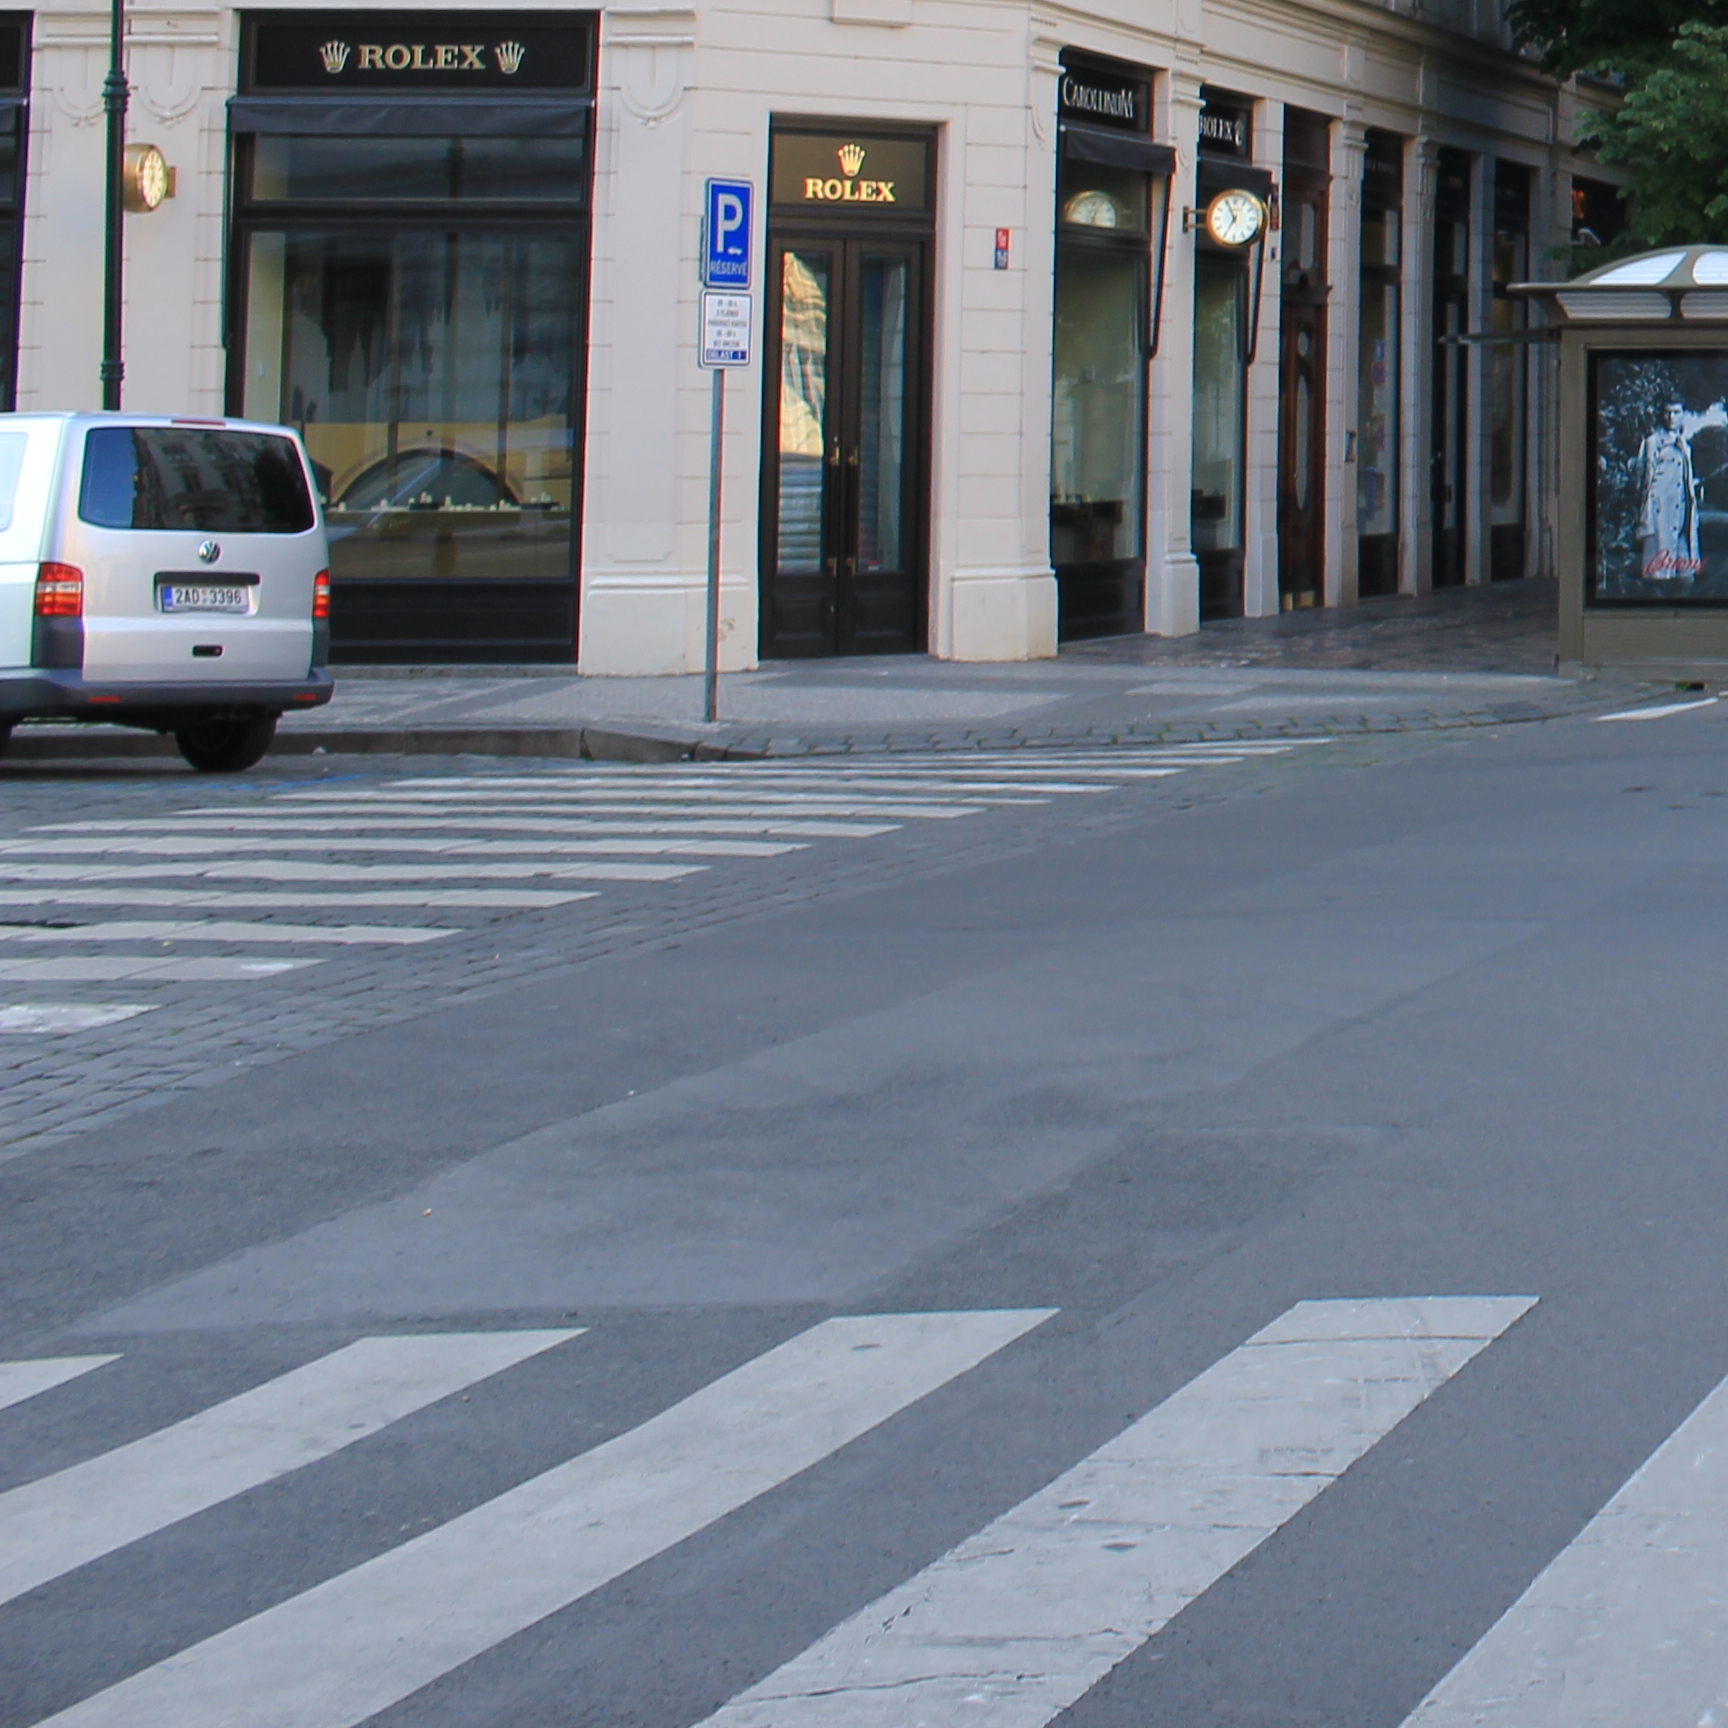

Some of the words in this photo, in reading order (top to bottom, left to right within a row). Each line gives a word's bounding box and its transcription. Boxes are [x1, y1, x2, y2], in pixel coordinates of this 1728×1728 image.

[358, 44, 486, 70] ROLEX
[804, 177, 896, 202] ROLEX
[716, 193, 743, 253] P
[710, 259, 747, 277] RÉSERVÉ
[209, 588, 242, 604] 3396
